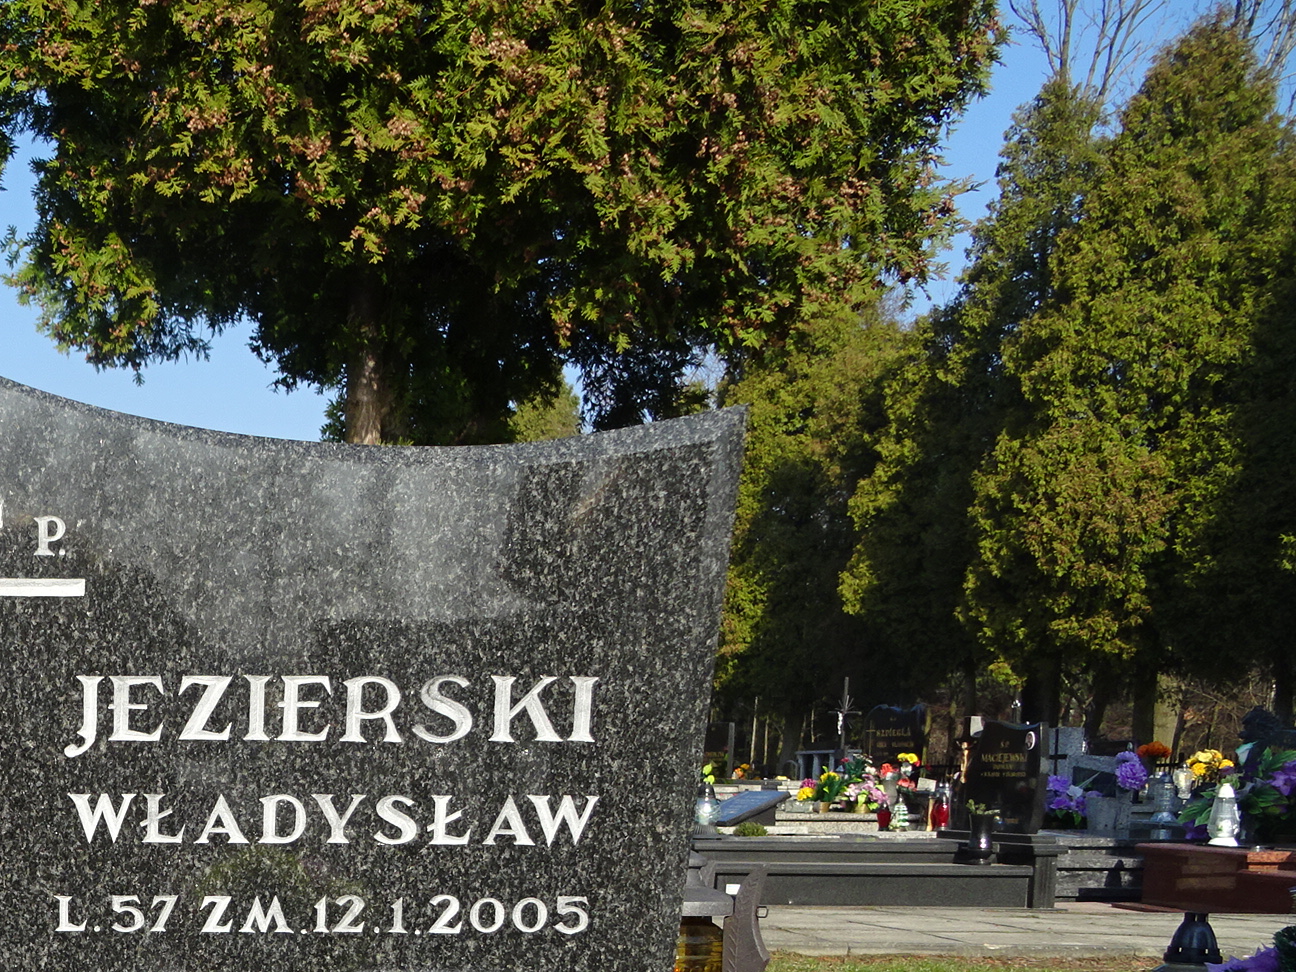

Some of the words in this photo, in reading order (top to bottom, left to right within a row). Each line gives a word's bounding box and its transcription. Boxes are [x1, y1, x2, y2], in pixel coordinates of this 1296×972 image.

[33, 514, 66, 557] P.
[63, 674, 600, 758] JEZIERSKI
[67, 792, 600, 848] WŁADYSŁAW
[53, 894, 179, 937] L.57
